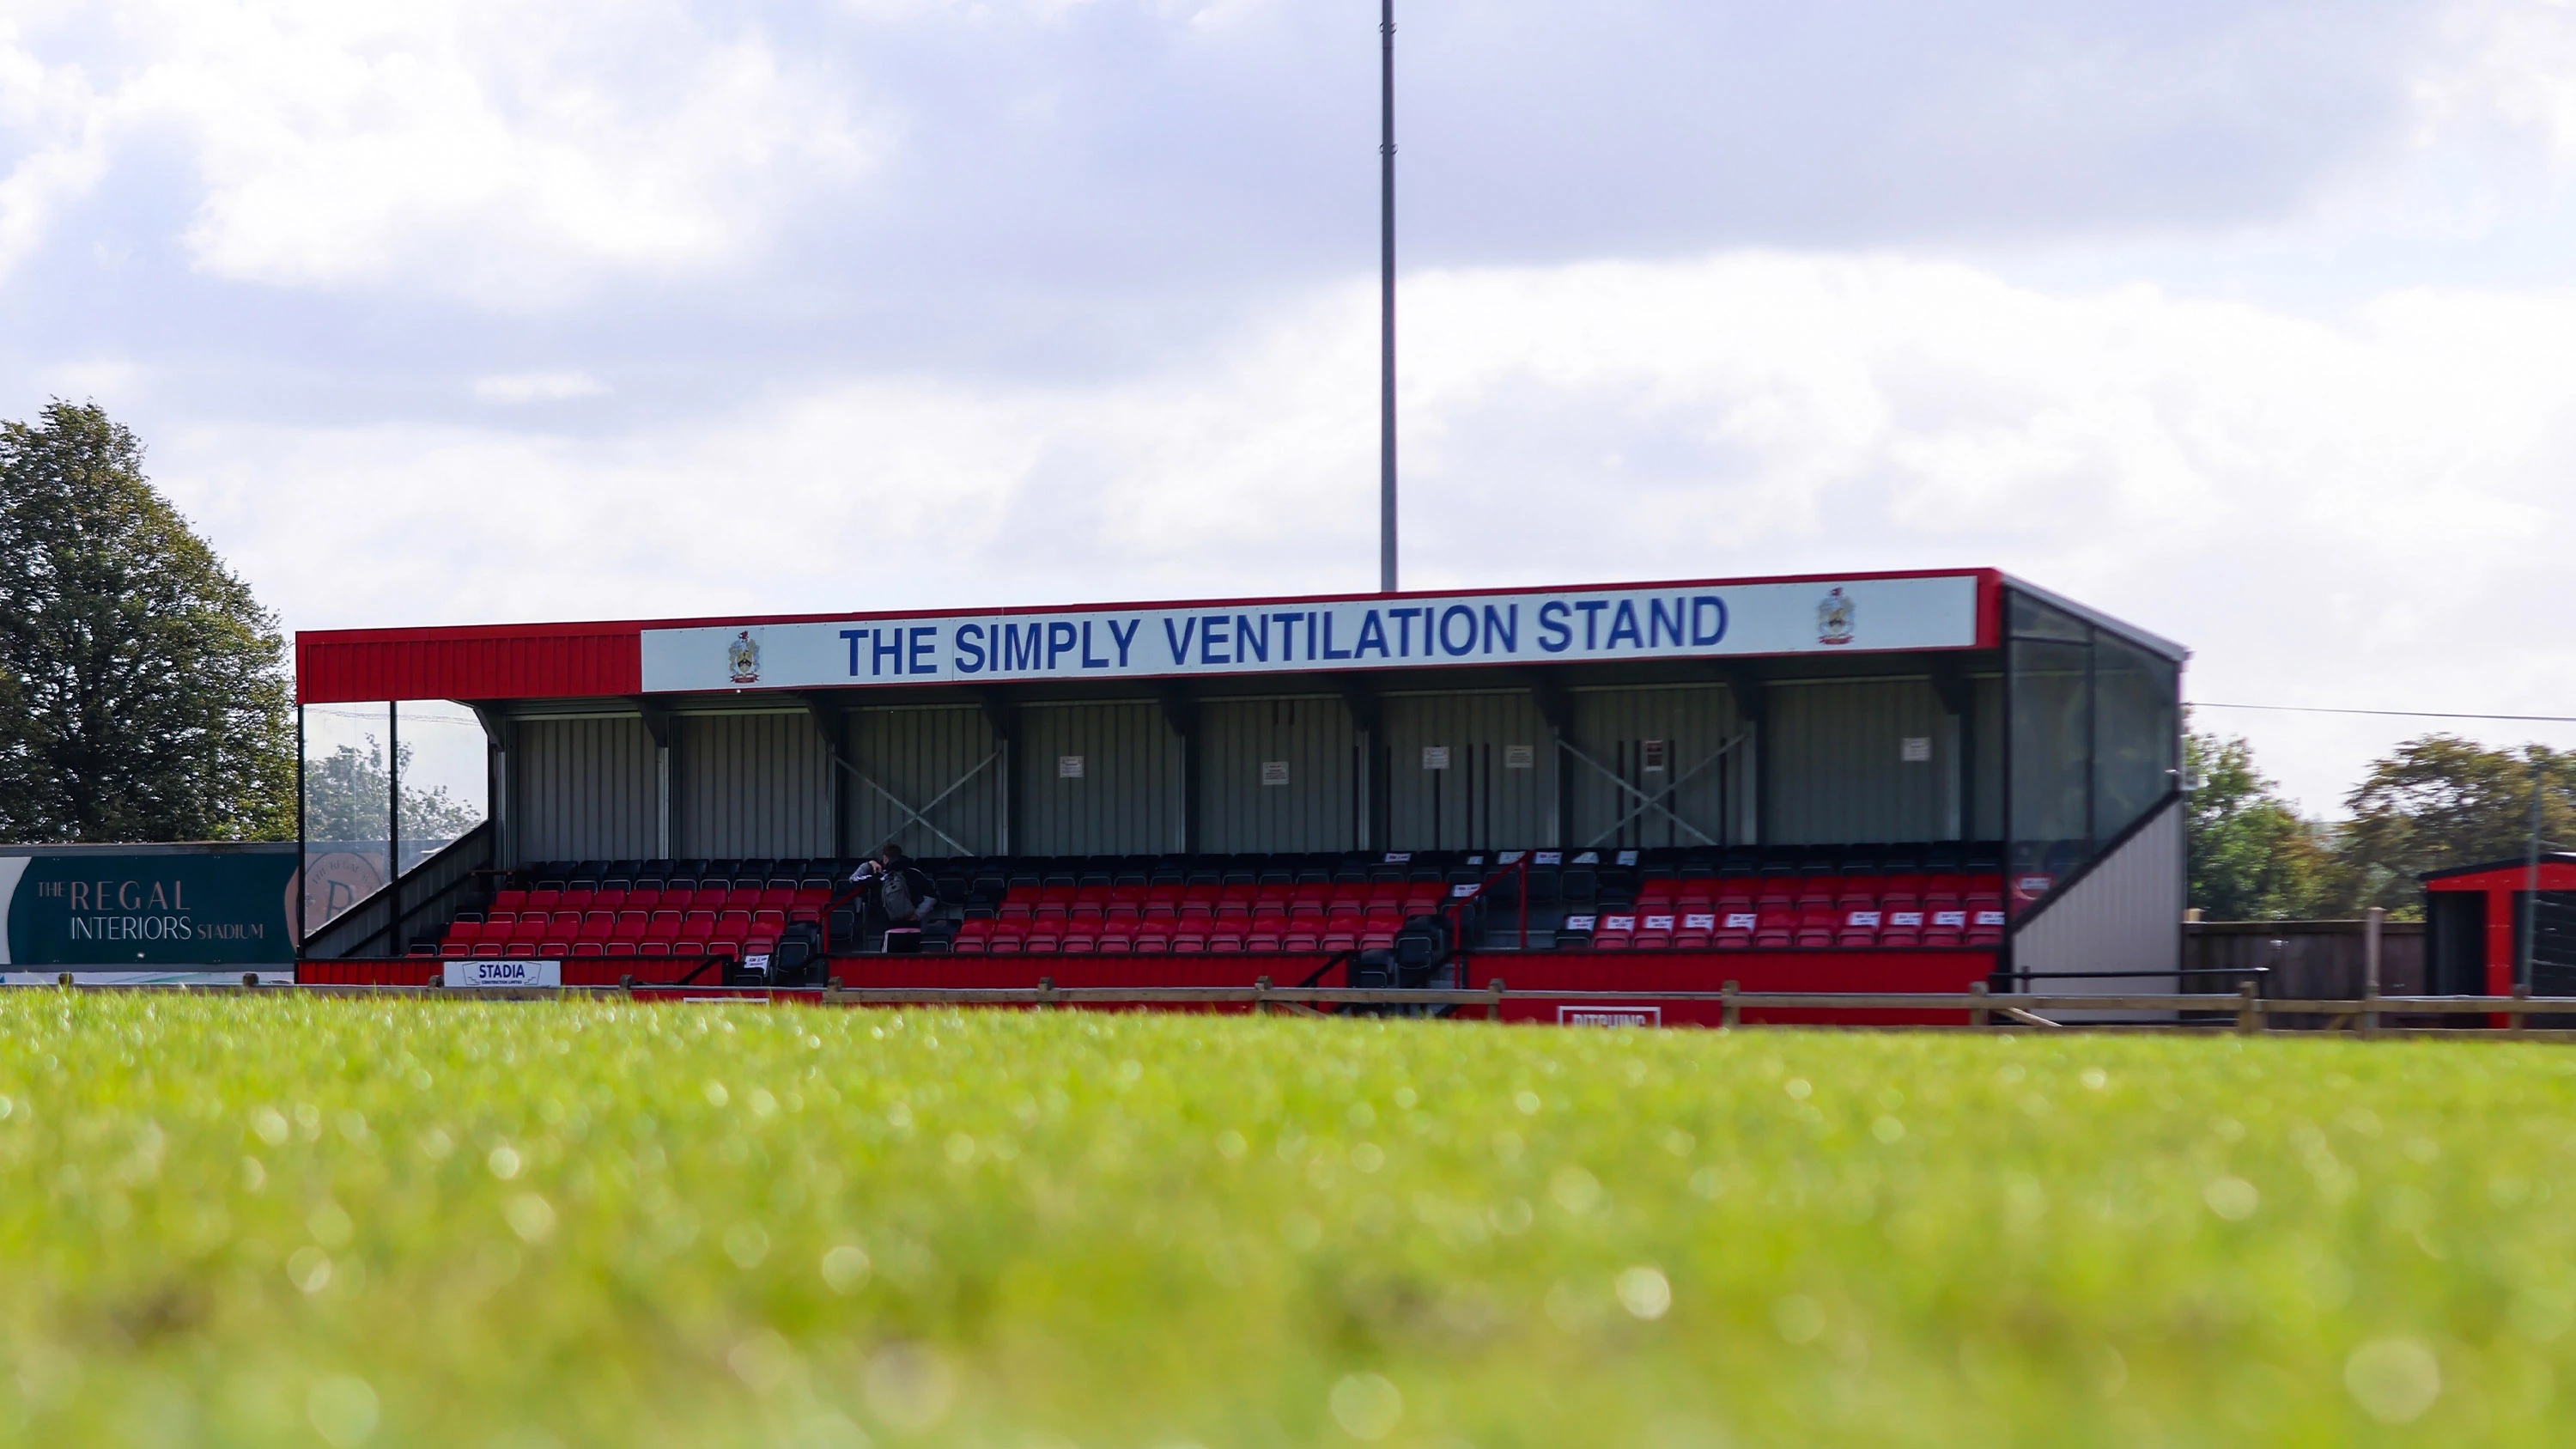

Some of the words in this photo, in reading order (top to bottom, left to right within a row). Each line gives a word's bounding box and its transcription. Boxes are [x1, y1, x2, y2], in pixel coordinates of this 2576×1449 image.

[839, 626, 938, 677] THE
[955, 618, 1141, 673] SIMPLY
[1163, 604, 1518, 666] VENTILATION
[1538, 595, 1728, 653] STAND
[38, 881, 66, 898] THE
[70, 880, 191, 910] REGAL
[70, 916, 192, 941] INTERIORS
[197, 923, 264, 941] STADIUM
[479, 964, 526, 979] STADIA
